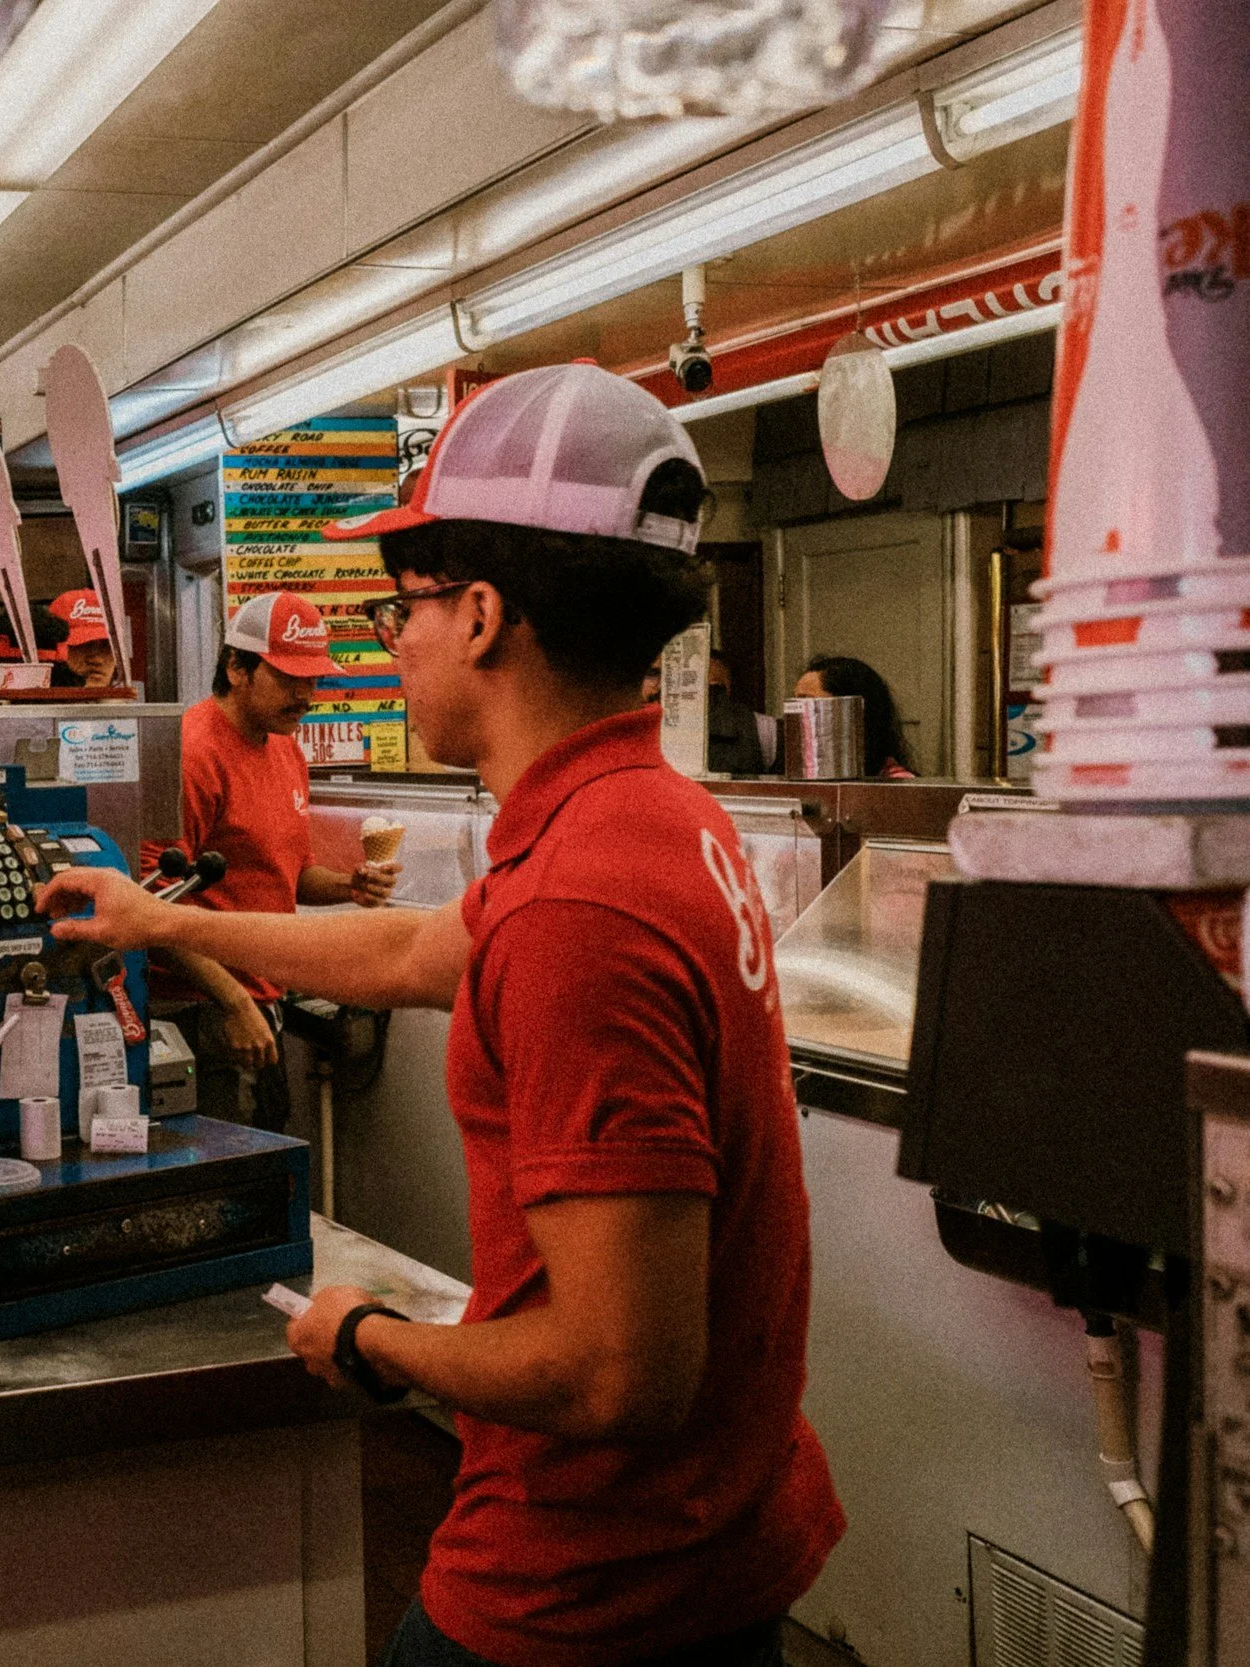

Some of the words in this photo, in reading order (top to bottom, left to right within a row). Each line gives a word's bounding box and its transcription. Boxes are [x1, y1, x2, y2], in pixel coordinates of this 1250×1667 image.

[239, 467, 269, 480] RUM
[276, 468, 319, 480] RAISIN
[241, 482, 298, 491] CHOCOLATE
[306, 482, 333, 491] CHIP
[239, 493, 301, 505] CHOCOLATE
[243, 520, 290, 530] BUTTER
[298, 520, 329, 530] PEC
[236, 544, 297, 555] CHOCOLATE
[236, 570, 270, 579] WHITE
[274, 568, 325, 579] CHOCOLATE
[295, 722, 363, 744] PRINKLES
